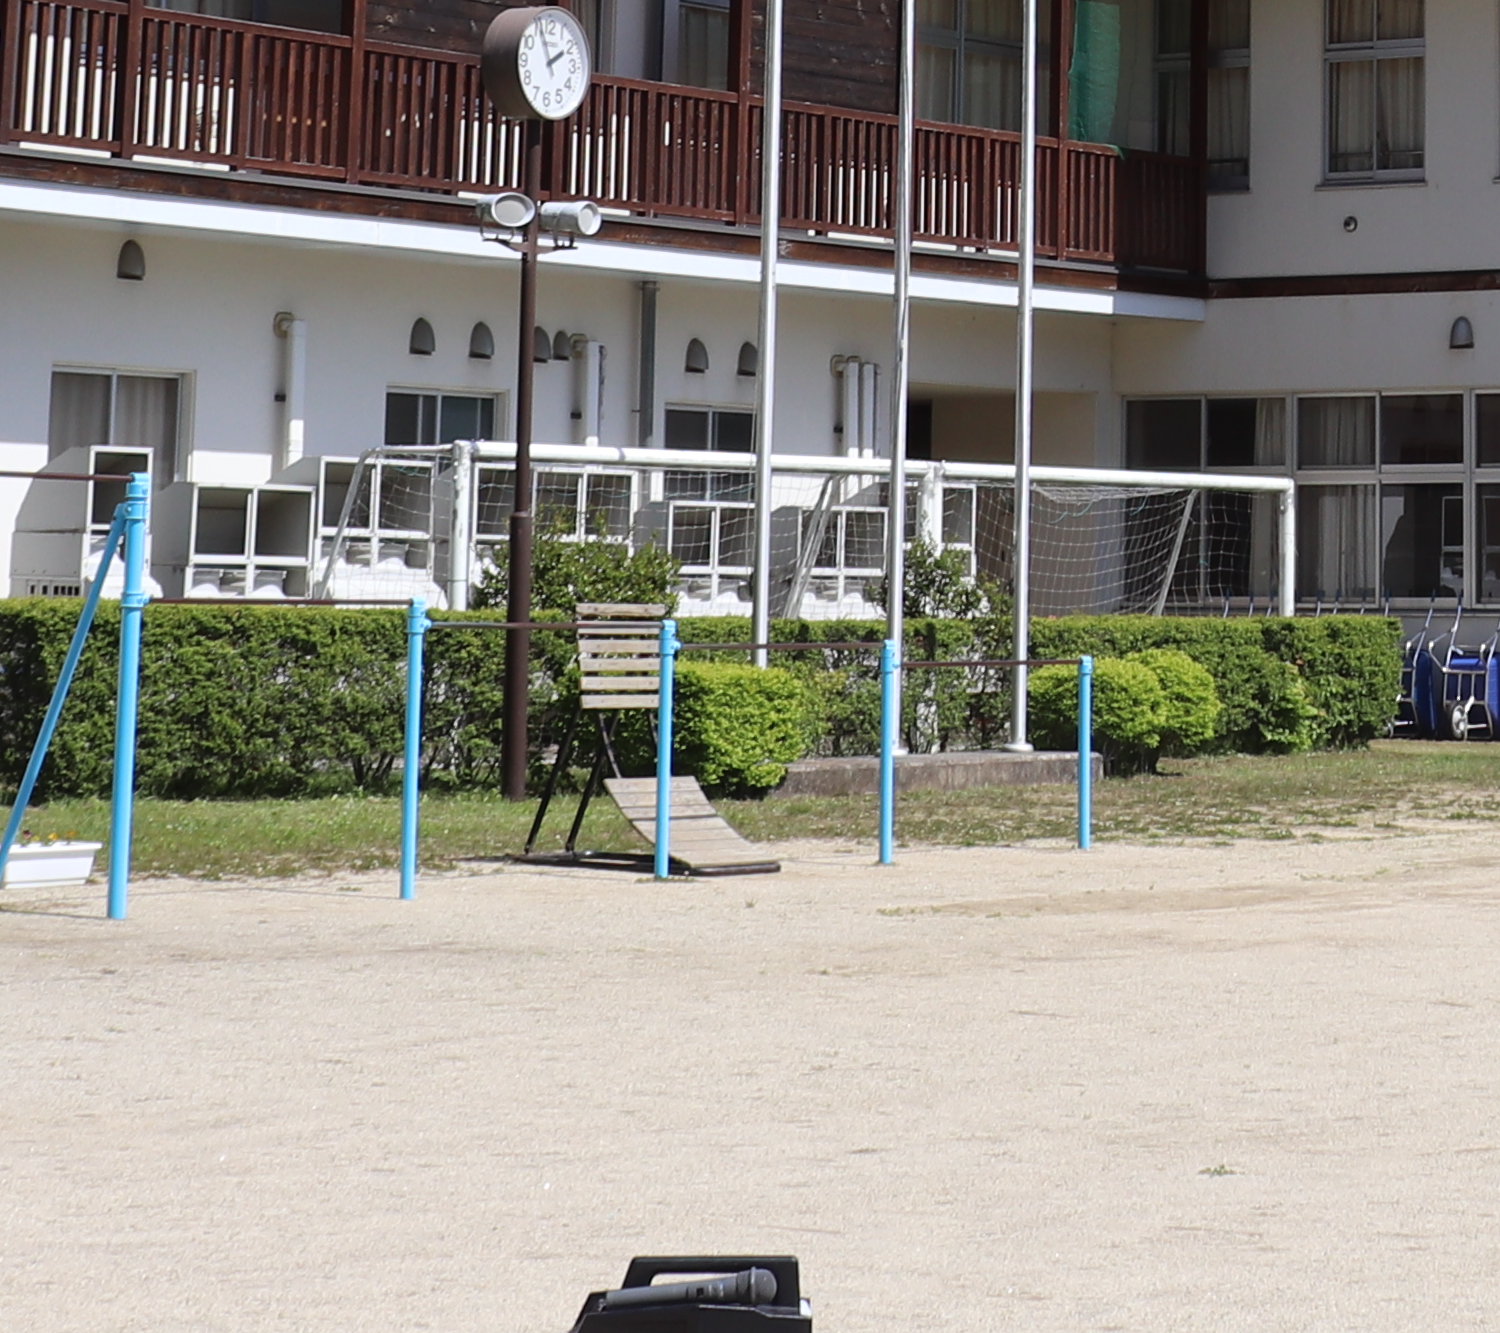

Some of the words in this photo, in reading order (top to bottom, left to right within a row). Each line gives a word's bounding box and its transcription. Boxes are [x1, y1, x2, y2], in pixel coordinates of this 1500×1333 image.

[544, 19, 556, 36] 12
[560, 26, 564, 40] 1
[522, 34, 535, 50] 10
[566, 39, 575, 55] 2
[519, 52, 528, 68] 9
[568, 58, 577, 74] 3
[523, 69, 532, 85] 8
[563, 76, 572, 91] 4
[532, 86, 540, 101] 7
[542, 91, 551, 107] 6
[555, 88, 563, 104] 5
